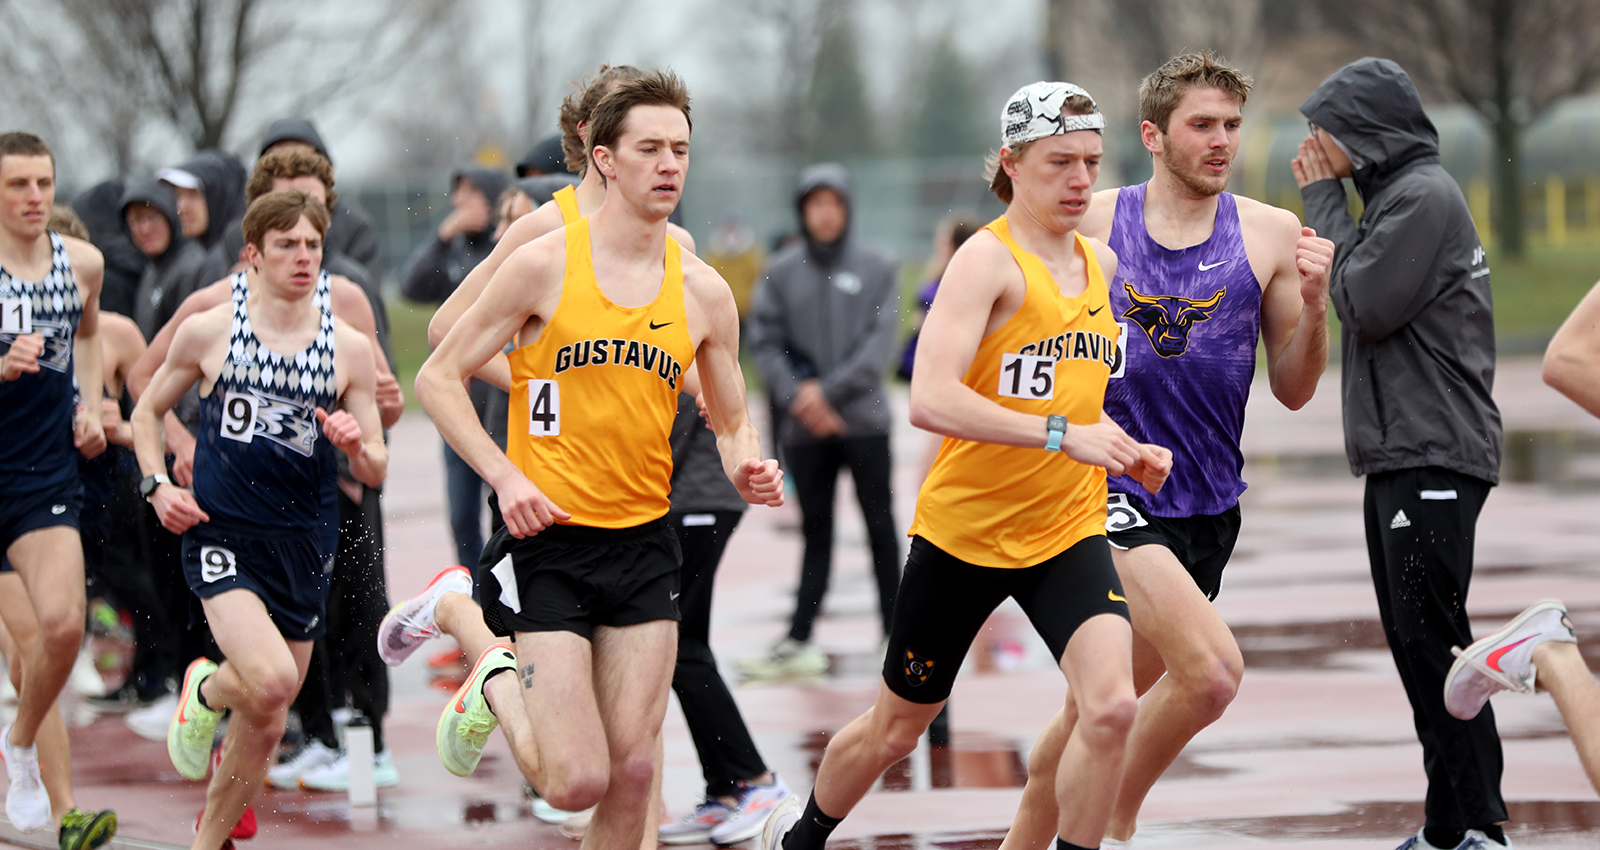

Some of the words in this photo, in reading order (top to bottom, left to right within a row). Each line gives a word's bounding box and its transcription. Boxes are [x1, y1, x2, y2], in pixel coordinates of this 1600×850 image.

[554, 338, 682, 391] GUSTAVUS
[1018, 330, 1115, 370] GUSTAVU
[1004, 358, 1052, 397] 15
[226, 398, 252, 435] 9
[532, 383, 556, 431] 4
[205, 550, 231, 576] 9
